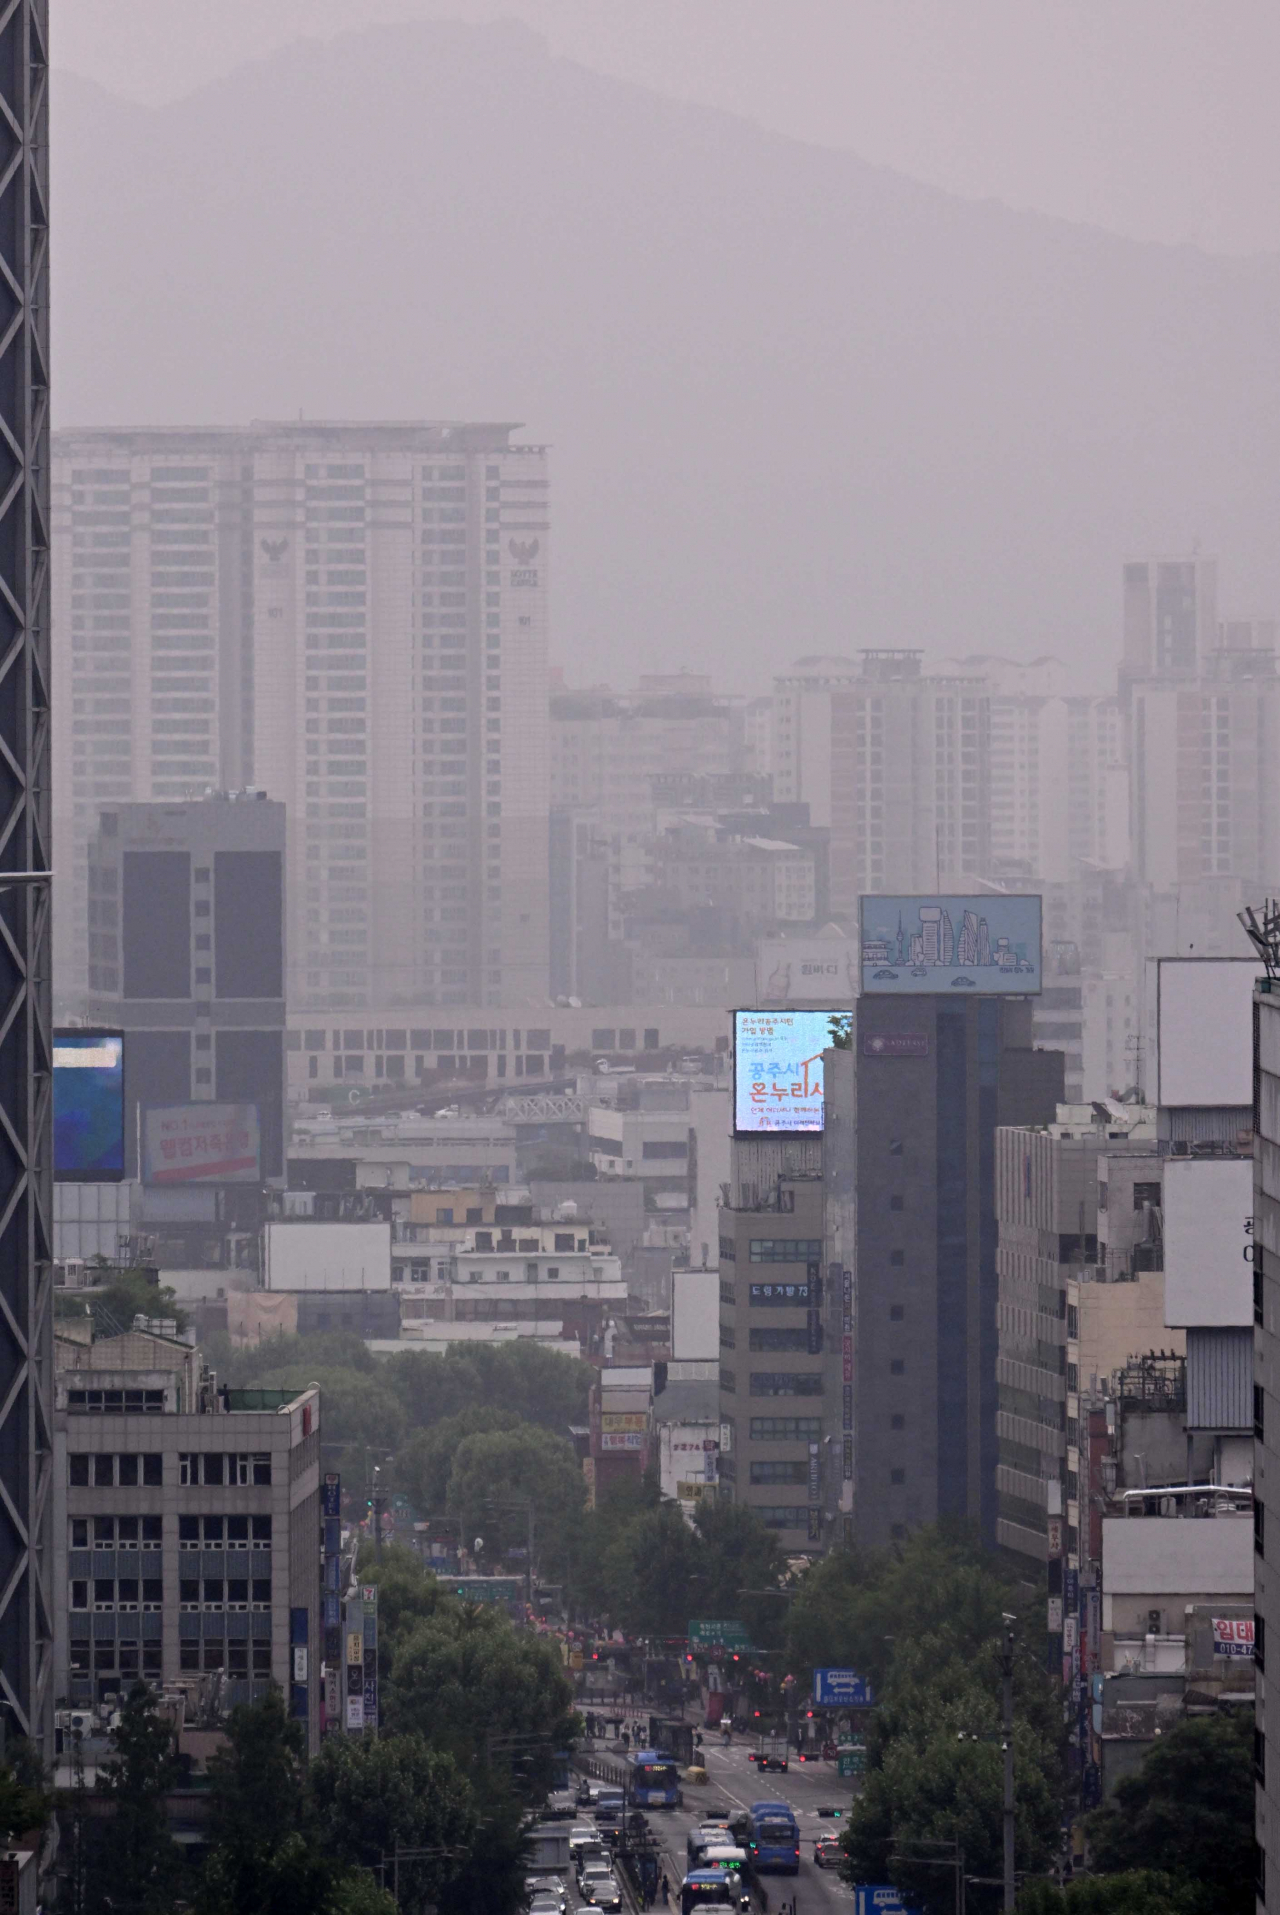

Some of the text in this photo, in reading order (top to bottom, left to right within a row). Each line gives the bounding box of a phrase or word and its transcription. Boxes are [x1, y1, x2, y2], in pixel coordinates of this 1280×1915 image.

[748, 1062, 800, 1080] 공주시
[752, 1286, 795, 1297] 드림가발
[328, 1485, 336, 1514] HOTEL
[1216, 1620, 1254, 1641] 임대
[364, 1682, 375, 1704] 사진
